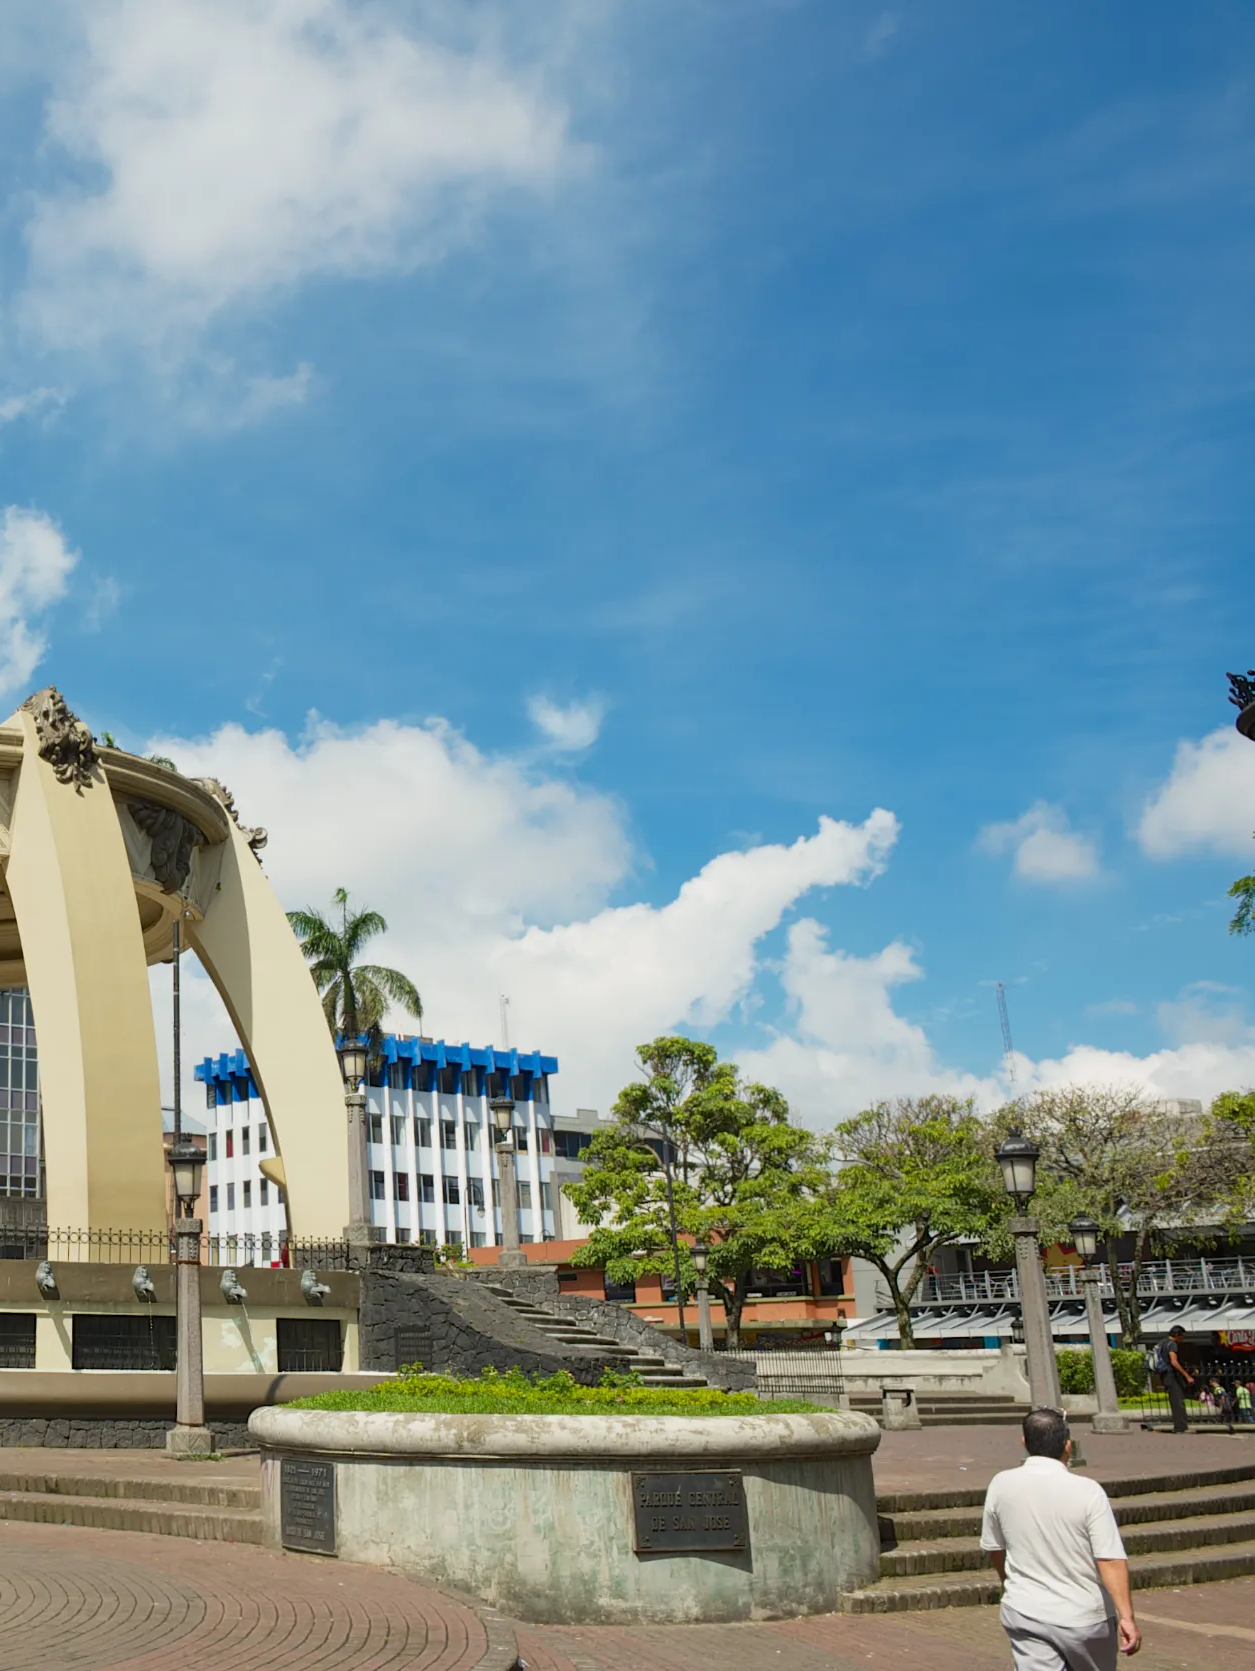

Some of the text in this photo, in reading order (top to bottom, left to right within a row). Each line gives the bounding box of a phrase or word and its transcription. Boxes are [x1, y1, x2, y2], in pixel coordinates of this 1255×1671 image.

[639, 1491, 740, 1508] PARQUE CENTRAL
[650, 1516, 666, 1532] DE
[672, 1515, 696, 1531] SAN
